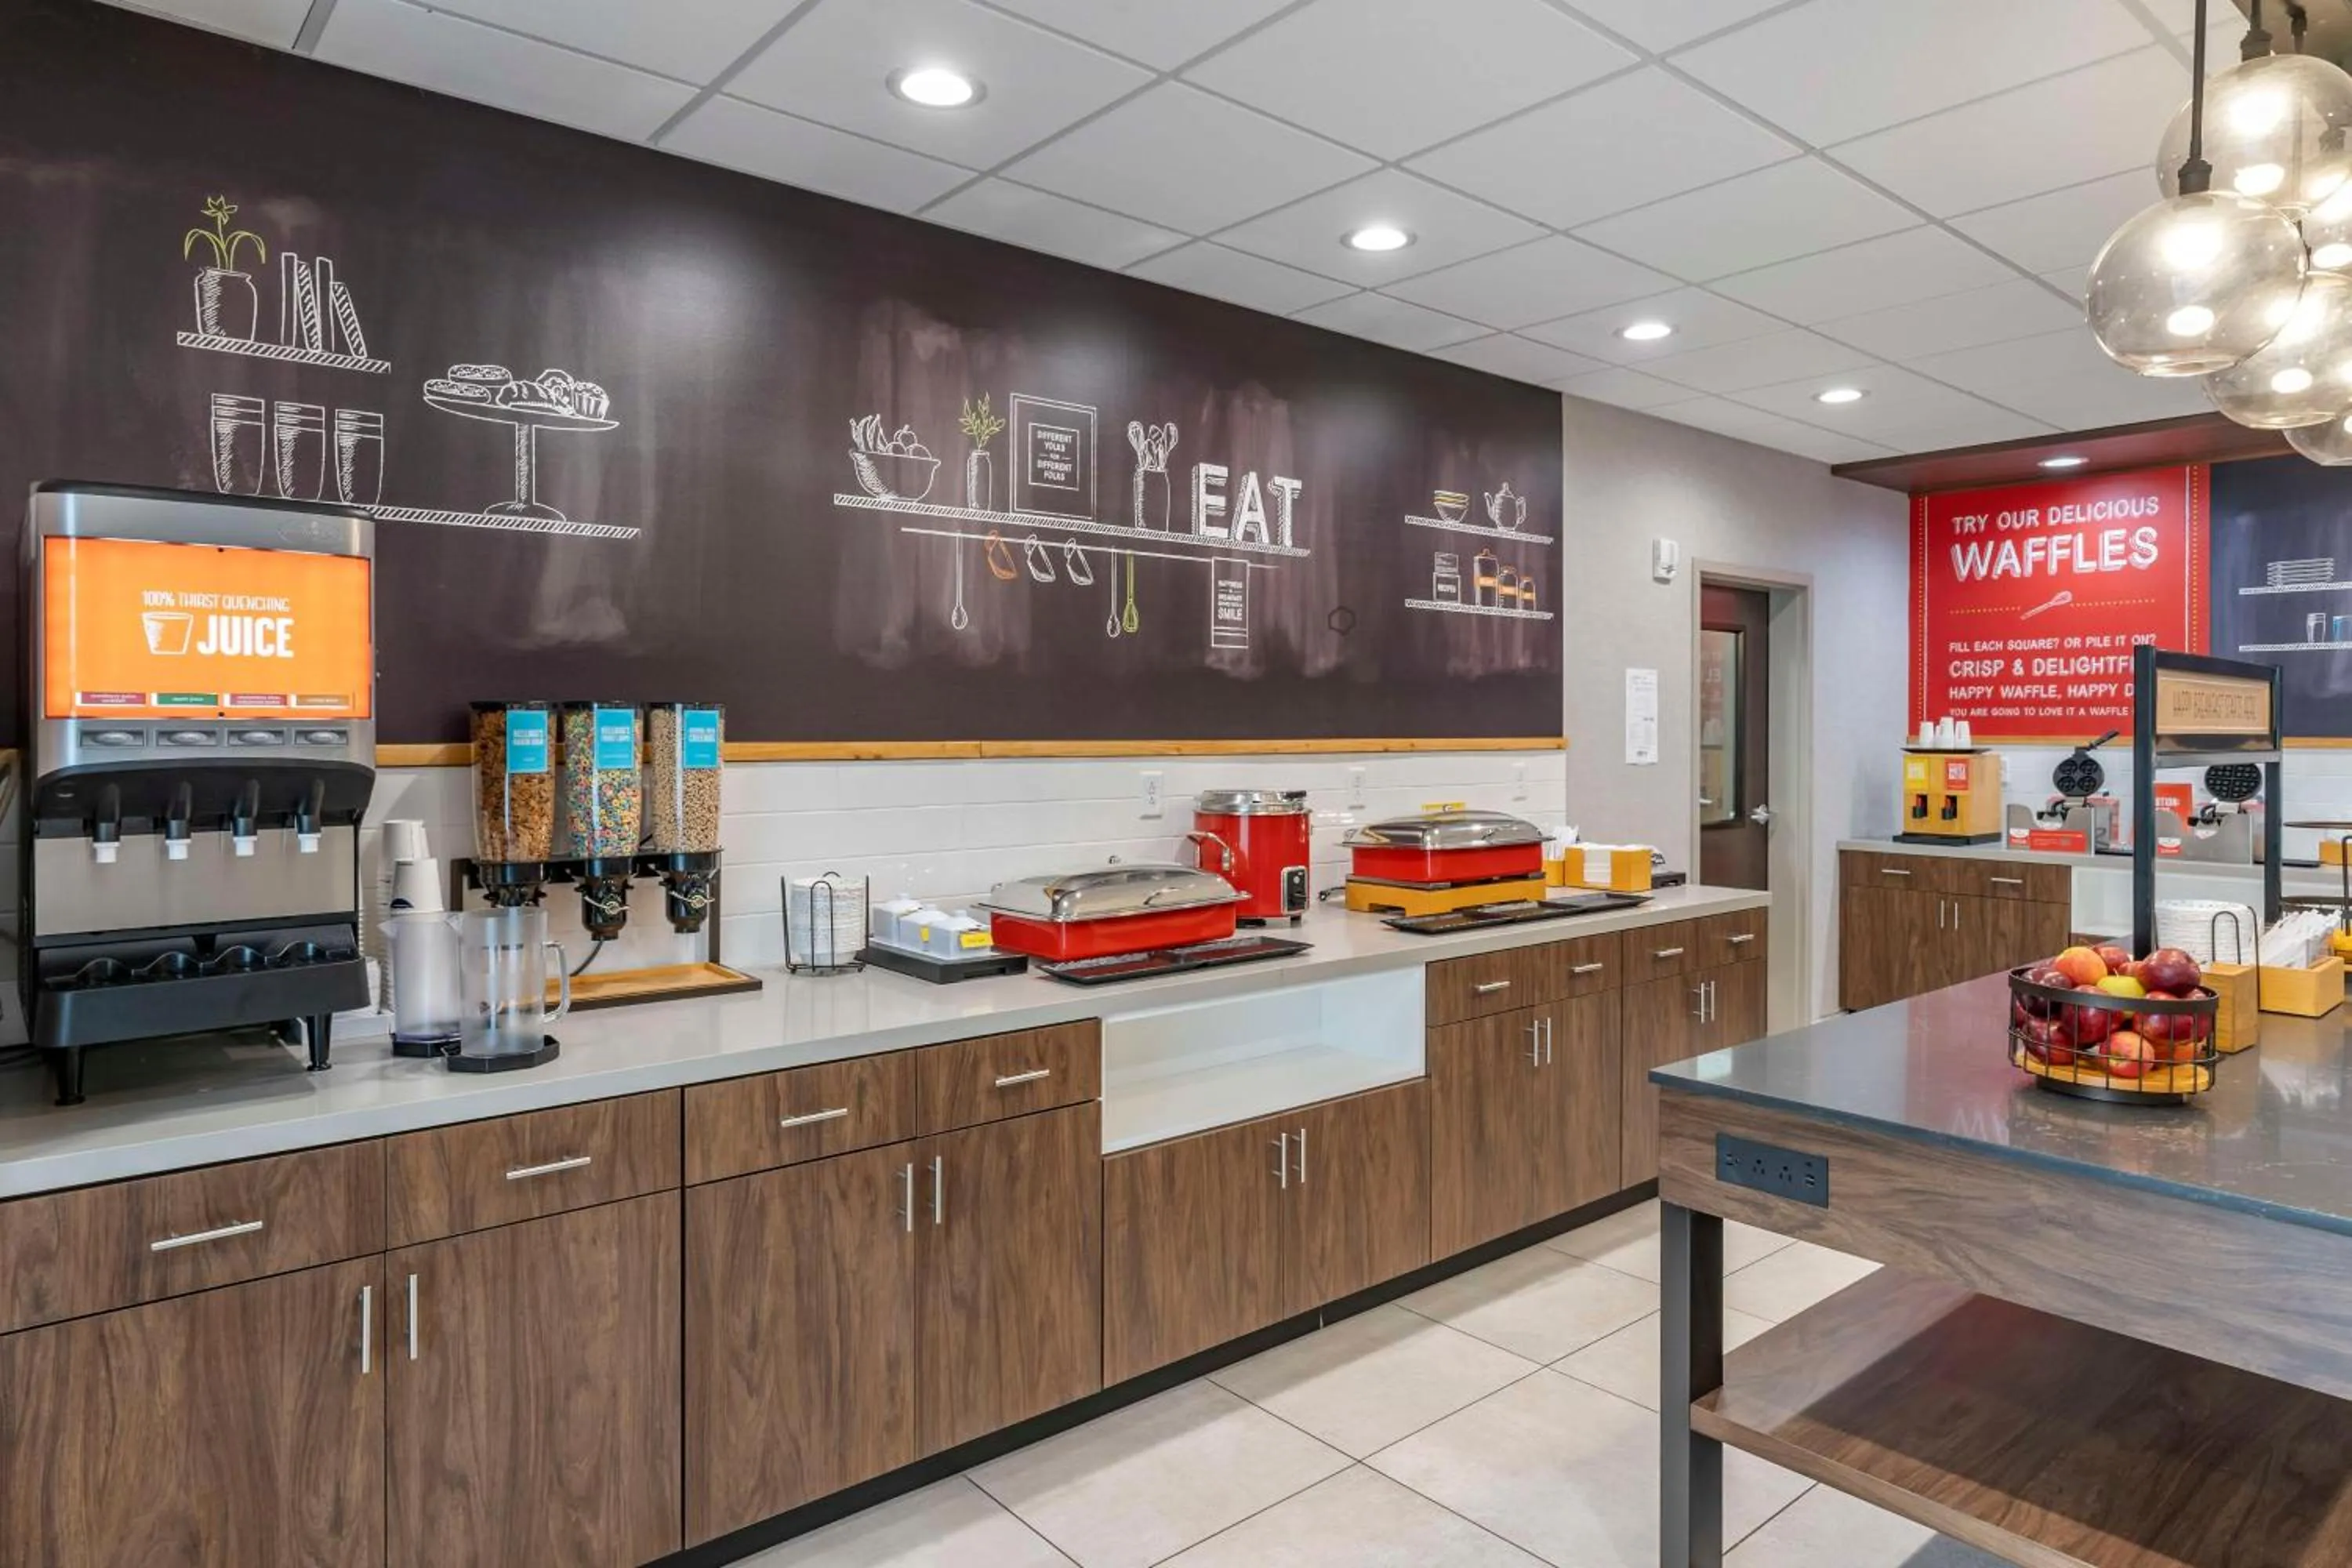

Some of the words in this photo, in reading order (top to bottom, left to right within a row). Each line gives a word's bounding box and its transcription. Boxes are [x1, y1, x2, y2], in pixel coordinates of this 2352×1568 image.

[1191, 463, 1302, 547] EAT
[1951, 514, 1989, 535] TRY
[1997, 508, 2039, 531] OUR
[2048, 496, 2159, 526] DELICIOUS
[1950, 526, 2158, 583] WAFFLES
[178, 593, 220, 608] THIRST
[197, 615, 294, 658] JUICE
[1949, 642, 1969, 653] FILL
[1974, 641, 2003, 652] EACH
[2007, 637, 2059, 651] SQUARE?
[2064, 637, 2082, 648] OR
[2085, 636, 2111, 648] PILE
[2115, 635, 2126, 646] IT
[1949, 659, 2004, 677] CRISP
[2013, 659, 2024, 676] &
[2032, 655, 2134, 677] DELIGHTF
[1949, 686, 1994, 699] HAPPY
[2001, 684, 2062, 699] WAFFLE,
[2067, 684, 2118, 698] HAPPY
[1970, 708, 1988, 717] ARE
[2089, 707, 2129, 716] WAFFLE
